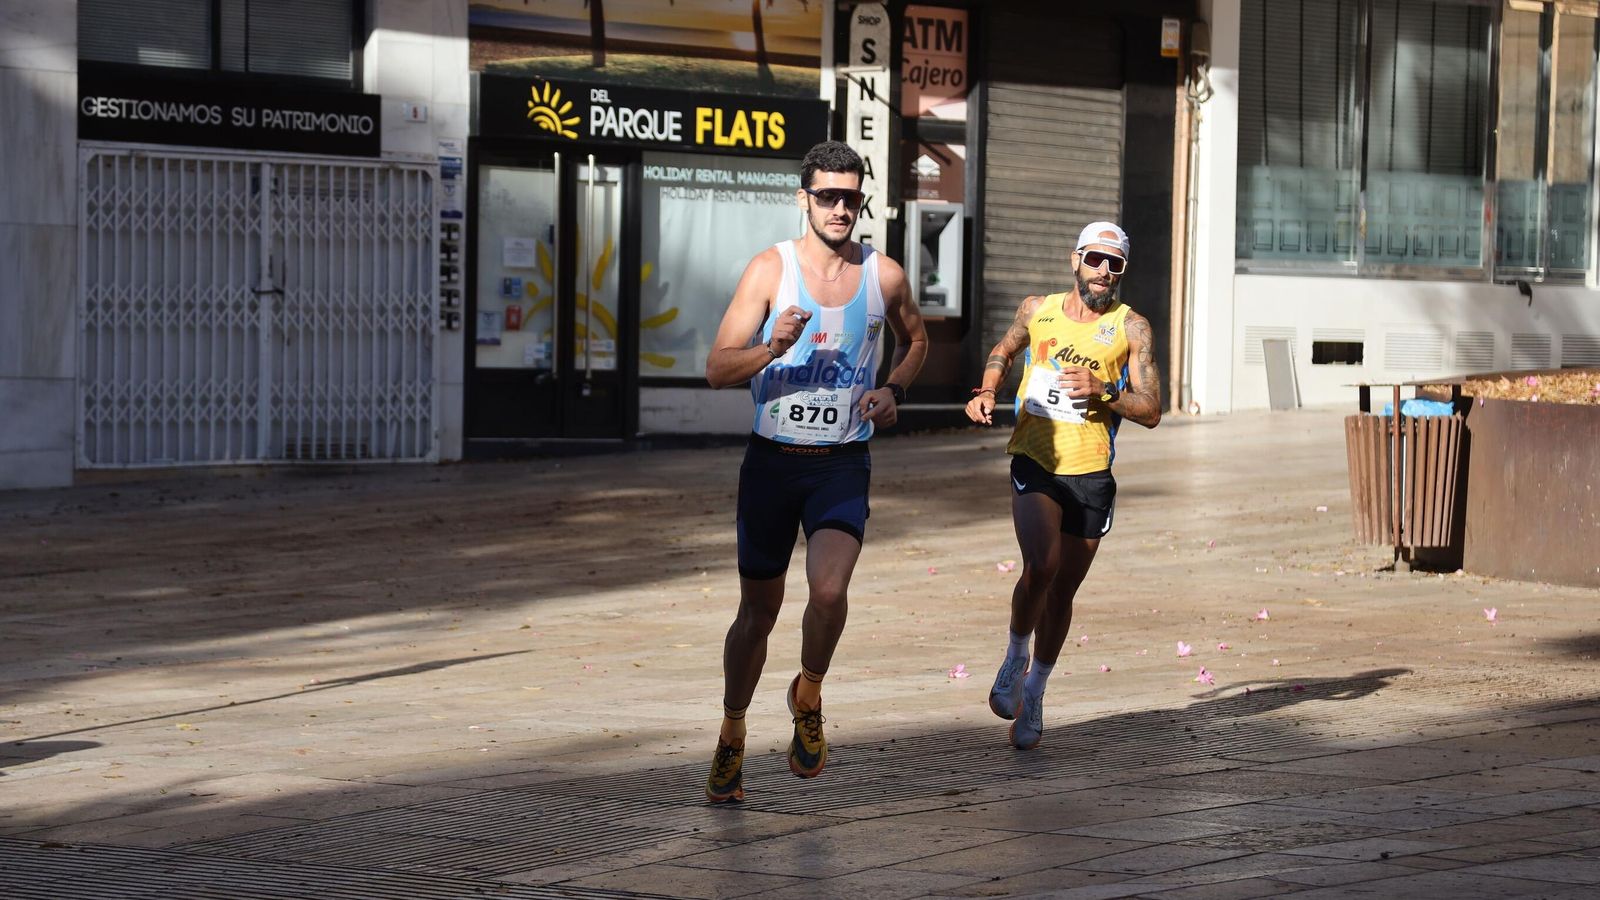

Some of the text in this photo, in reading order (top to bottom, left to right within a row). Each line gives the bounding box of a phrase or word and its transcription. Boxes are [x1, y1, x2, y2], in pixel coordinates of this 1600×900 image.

[858, 15, 880, 25] SHOP
[903, 16, 963, 52] ATM
[590, 88, 611, 103] DEL
[81, 97, 374, 134] GESTIONAMOS SU PATRIMONIO
[589, 105, 785, 149] PARQUE FLATS
[643, 166, 694, 181] HOLIDAY
[695, 168, 734, 183] RENTAL
[1054, 344, 1100, 371] Álora
[1046, 388, 1061, 405] 5
[788, 404, 838, 425] 870
